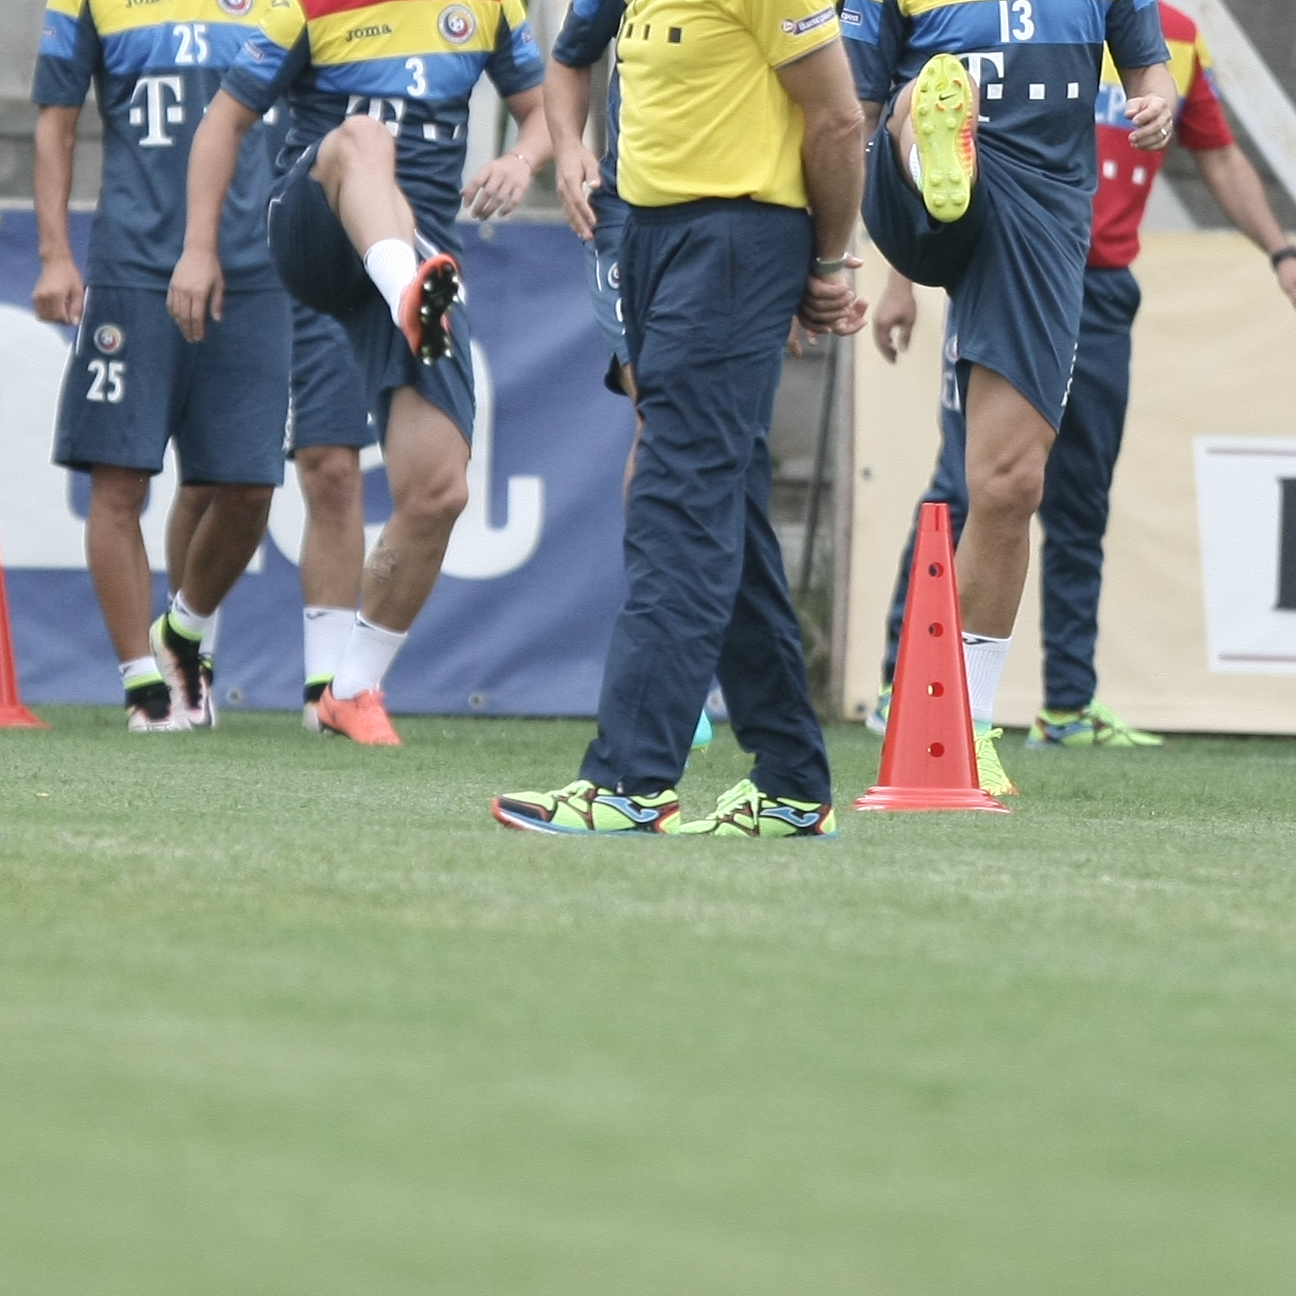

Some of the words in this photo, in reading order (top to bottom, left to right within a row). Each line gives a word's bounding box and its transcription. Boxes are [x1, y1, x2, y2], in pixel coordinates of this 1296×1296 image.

[172, 23, 210, 65] 25
[405, 57, 428, 98] 3
[85, 359, 126, 404] 25
